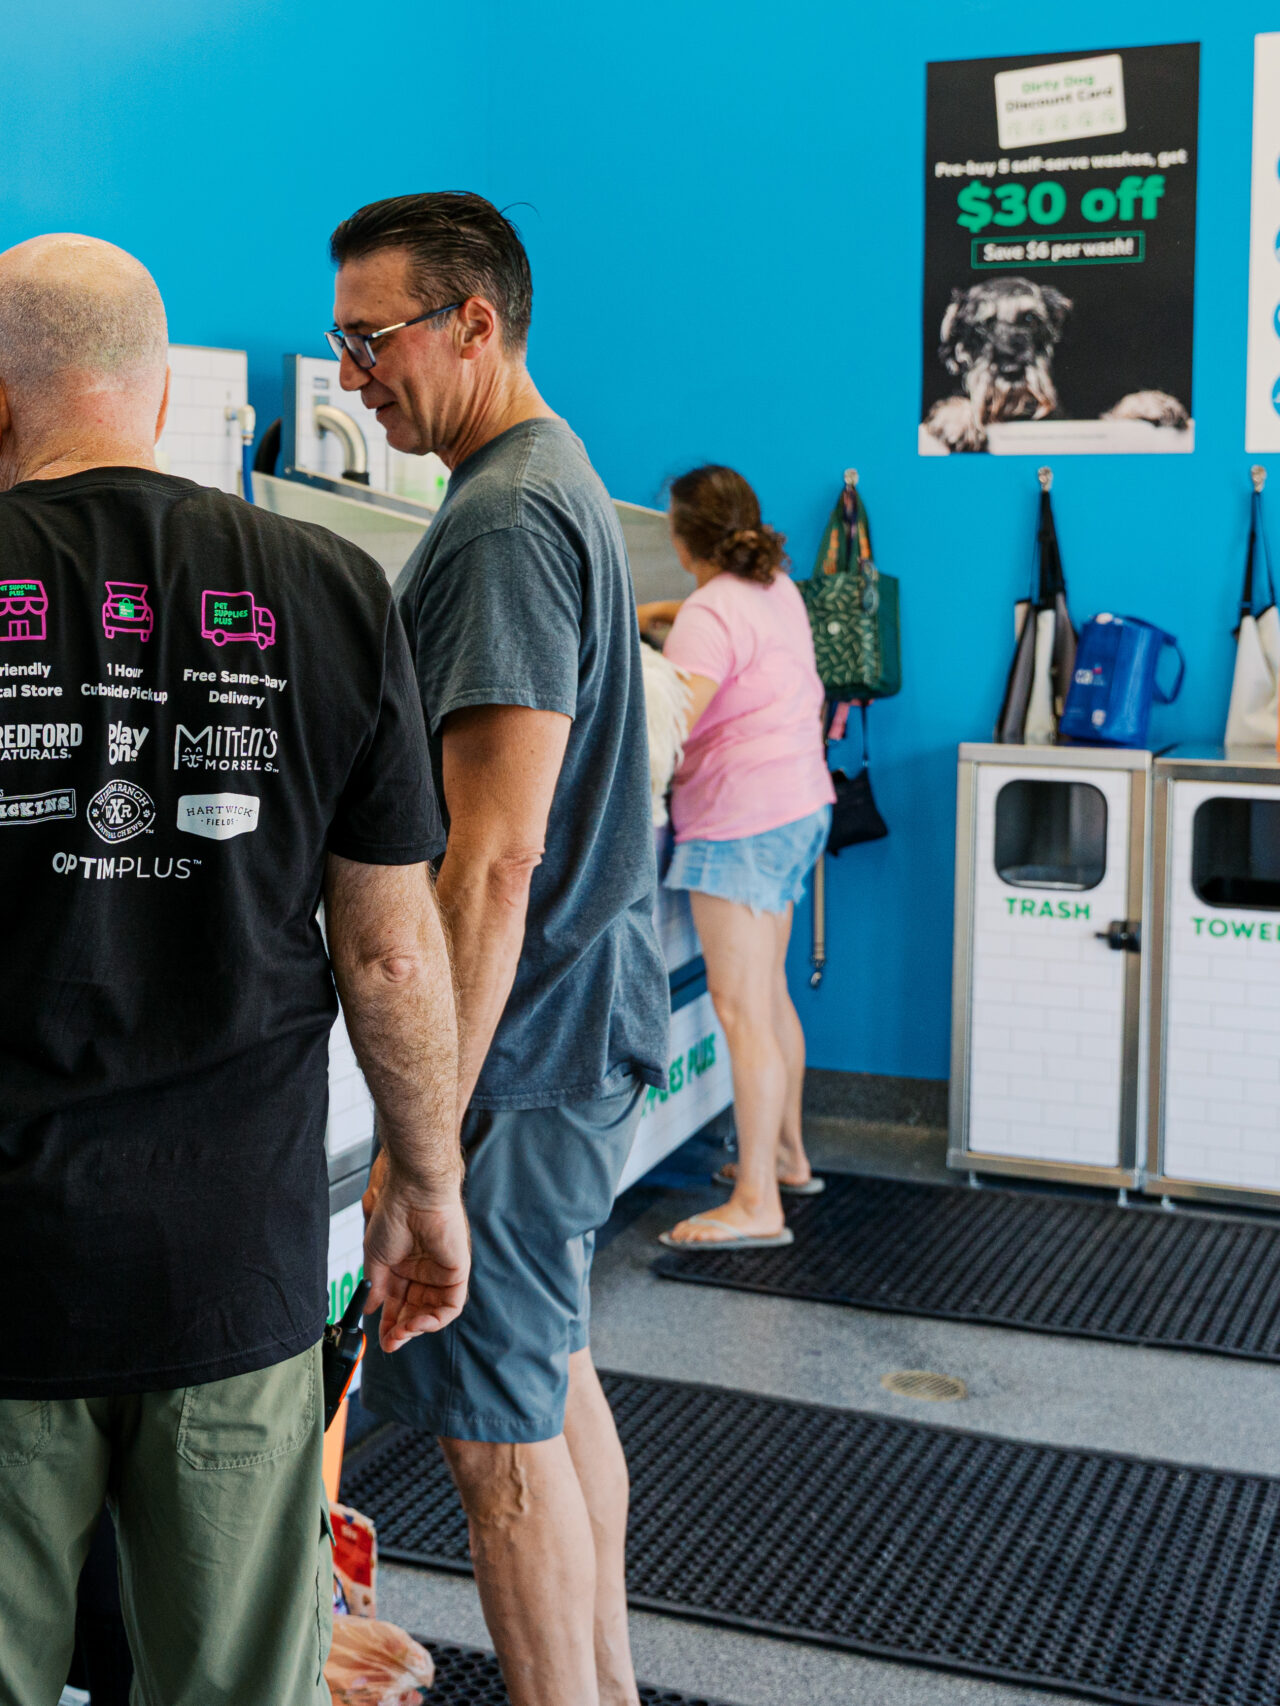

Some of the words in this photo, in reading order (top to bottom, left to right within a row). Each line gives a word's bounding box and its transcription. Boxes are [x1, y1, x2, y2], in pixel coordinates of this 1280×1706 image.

[935, 160, 997, 178] Pre-buy
[1011, 155, 1090, 174] self-serve
[1157, 148, 1188, 168] get
[956, 180, 1067, 233] $30
[1081, 174, 1166, 223] off
[983, 243, 1025, 262] Save
[1051, 242, 1081, 263] per
[1082, 236, 1134, 257] wash!
[213, 617, 233, 625] PLUS
[214, 609, 248, 618] SUPPLIES
[107, 663, 112, 675] 1
[115, 664, 143, 678] Hour
[183, 669, 217, 682] Free
[220, 670, 287, 692] Same-Day
[20, 684, 63, 697] Store
[130, 686, 168, 704] Pickup
[209, 690, 265, 709] Delivery
[205, 759, 273, 772] MORSELS
[117, 778, 150, 807] RANCH
[186, 805, 253, 818] HARTWICK
[206, 818, 234, 826] FIELDS
[1005, 897, 1091, 921] TRASH
